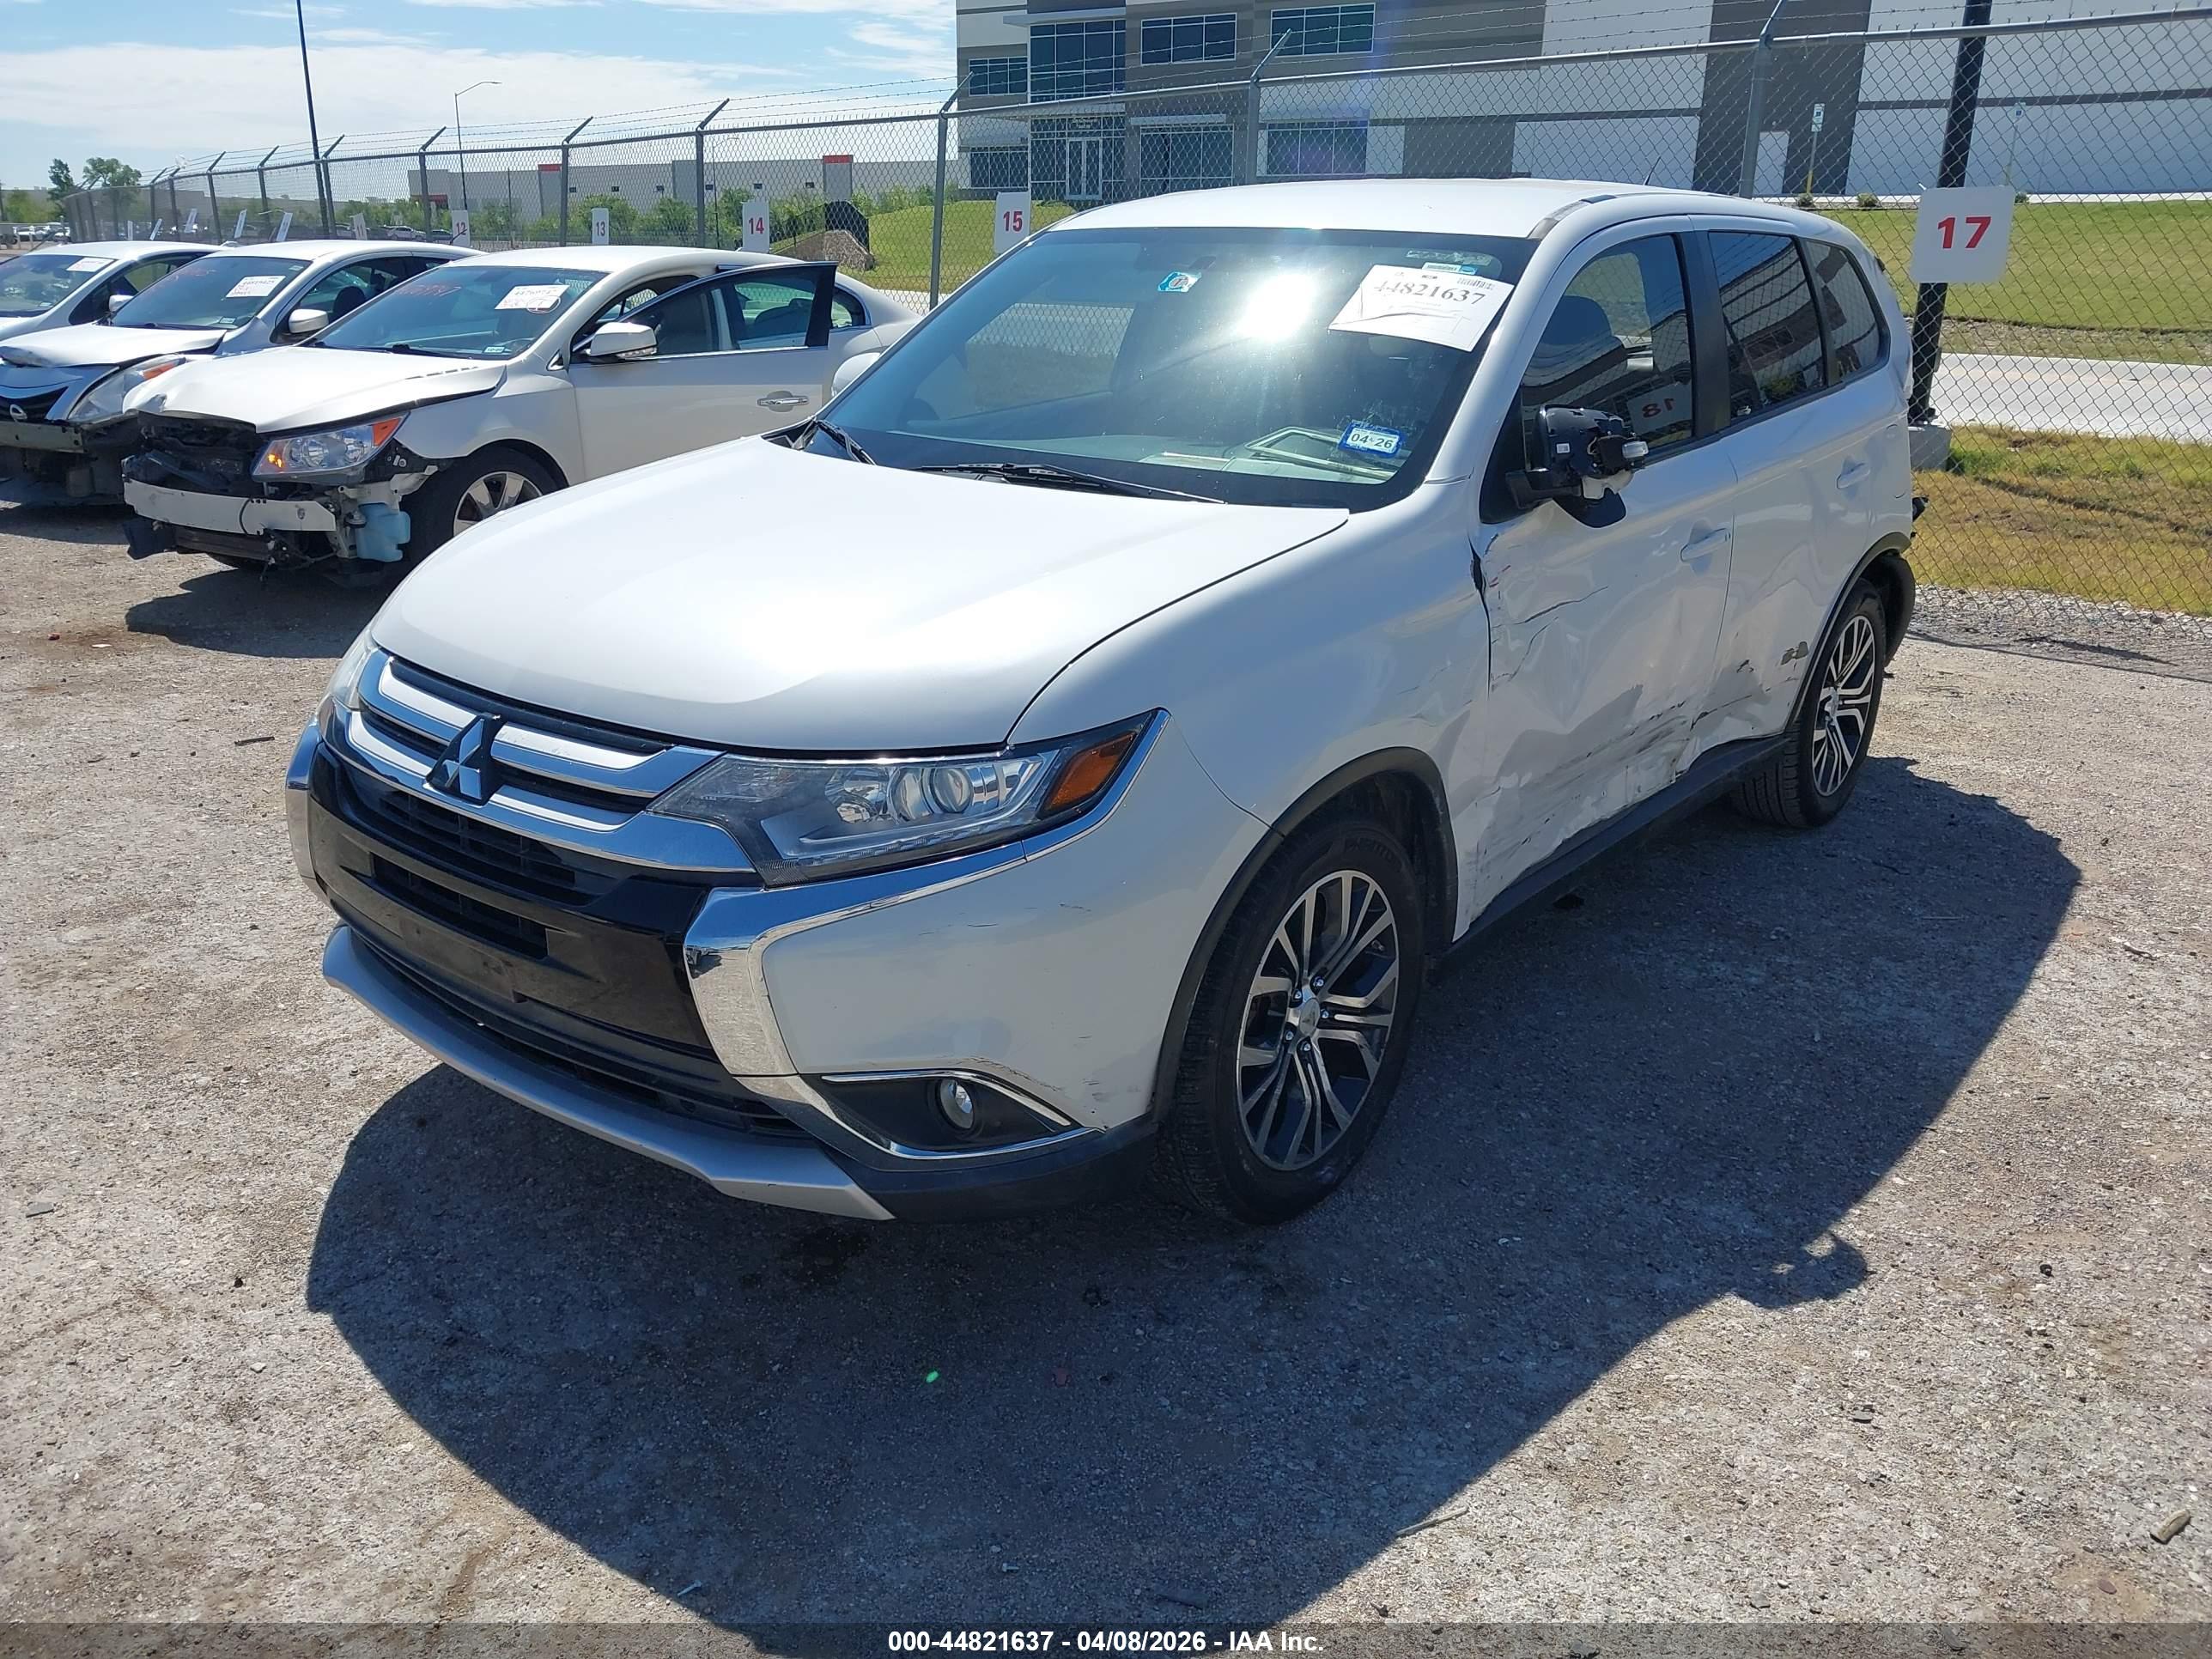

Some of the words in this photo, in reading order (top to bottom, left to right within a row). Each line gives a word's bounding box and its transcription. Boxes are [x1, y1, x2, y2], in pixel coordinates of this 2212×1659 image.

[455, 222, 467, 236] 12
[594, 221, 607, 237] 13
[748, 217, 764, 234] 14
[1002, 210, 1023, 233] 15
[1937, 216, 1992, 249] 17
[1373, 280, 1487, 305] 44821637
[1351, 433, 1370, 444] 04
[1373, 438, 1395, 449] 26
